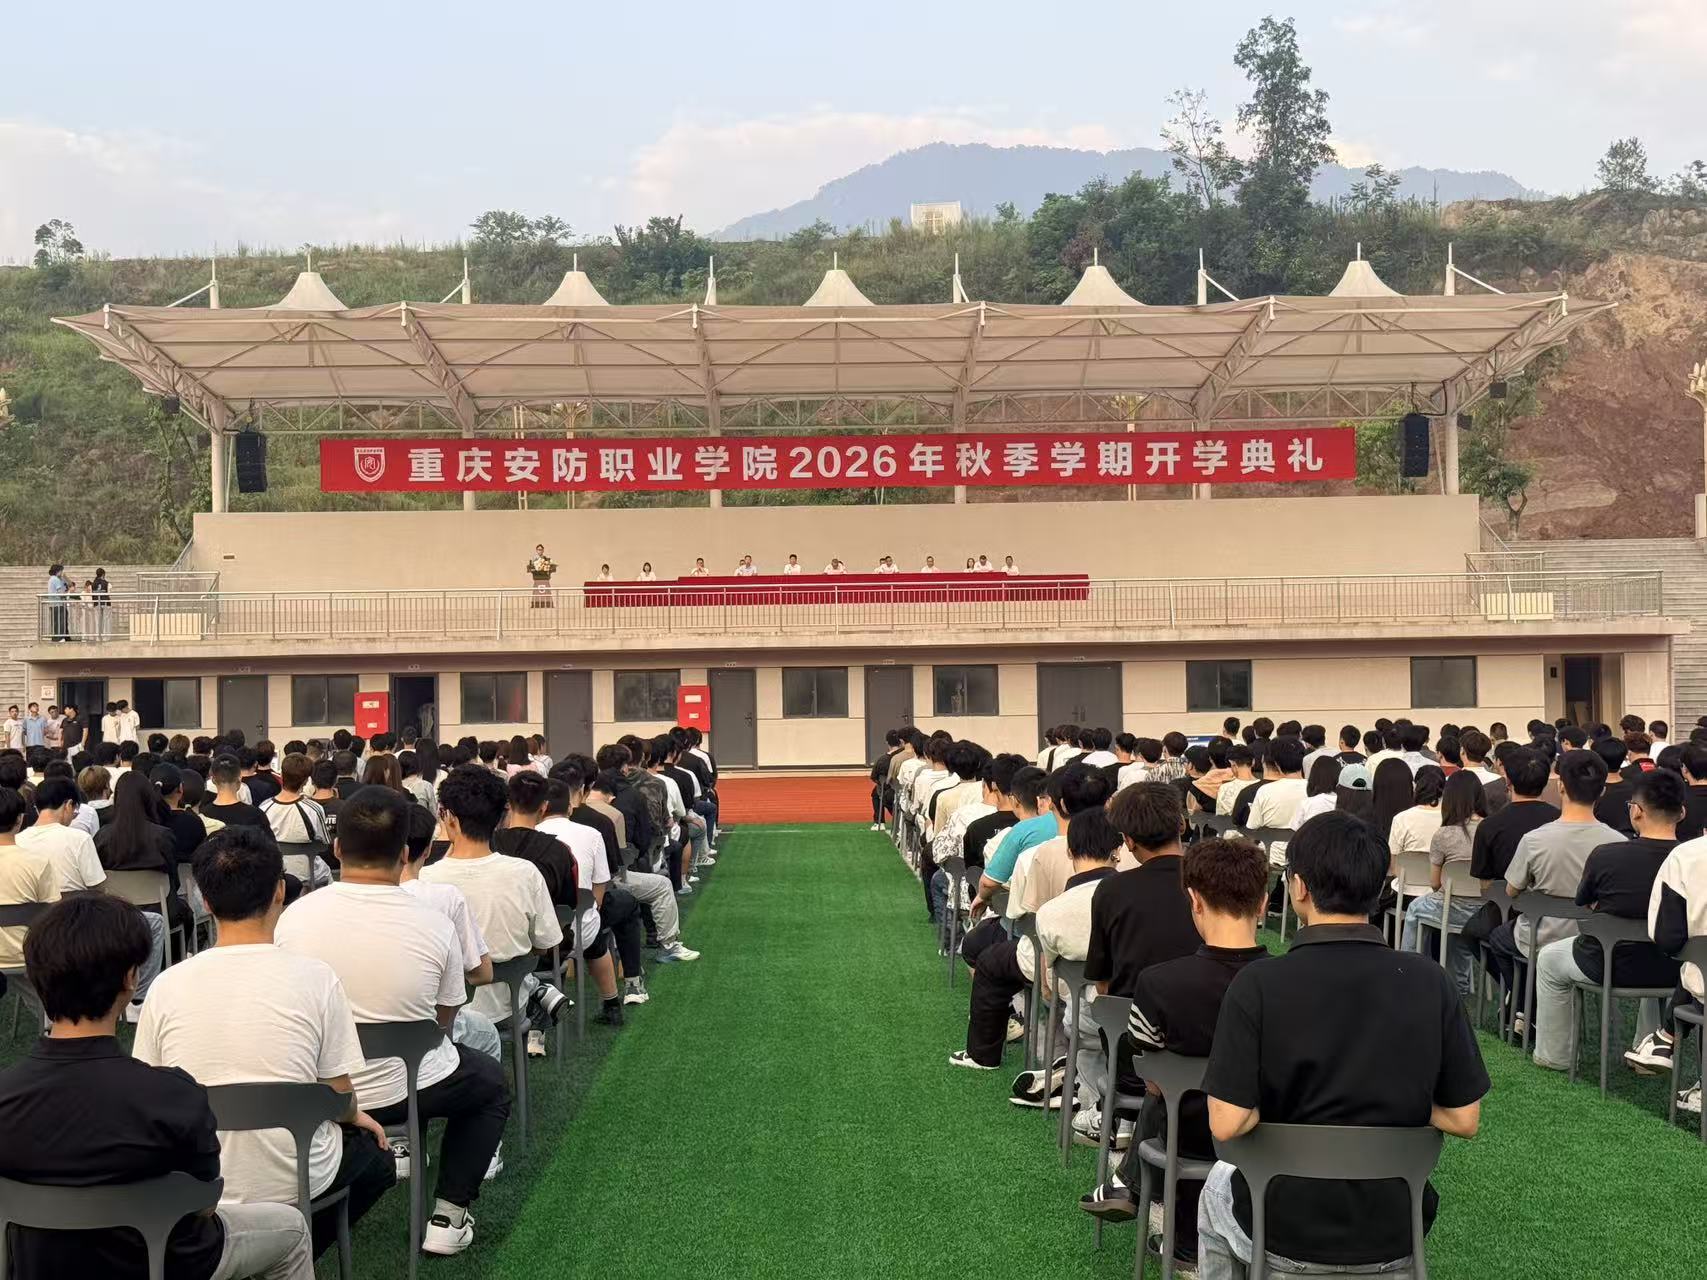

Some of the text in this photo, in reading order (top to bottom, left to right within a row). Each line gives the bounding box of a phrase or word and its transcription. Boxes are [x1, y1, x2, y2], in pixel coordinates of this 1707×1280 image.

[407, 437, 1323, 483] 重庆安防职业学院2026年秋季学期开学典礼
